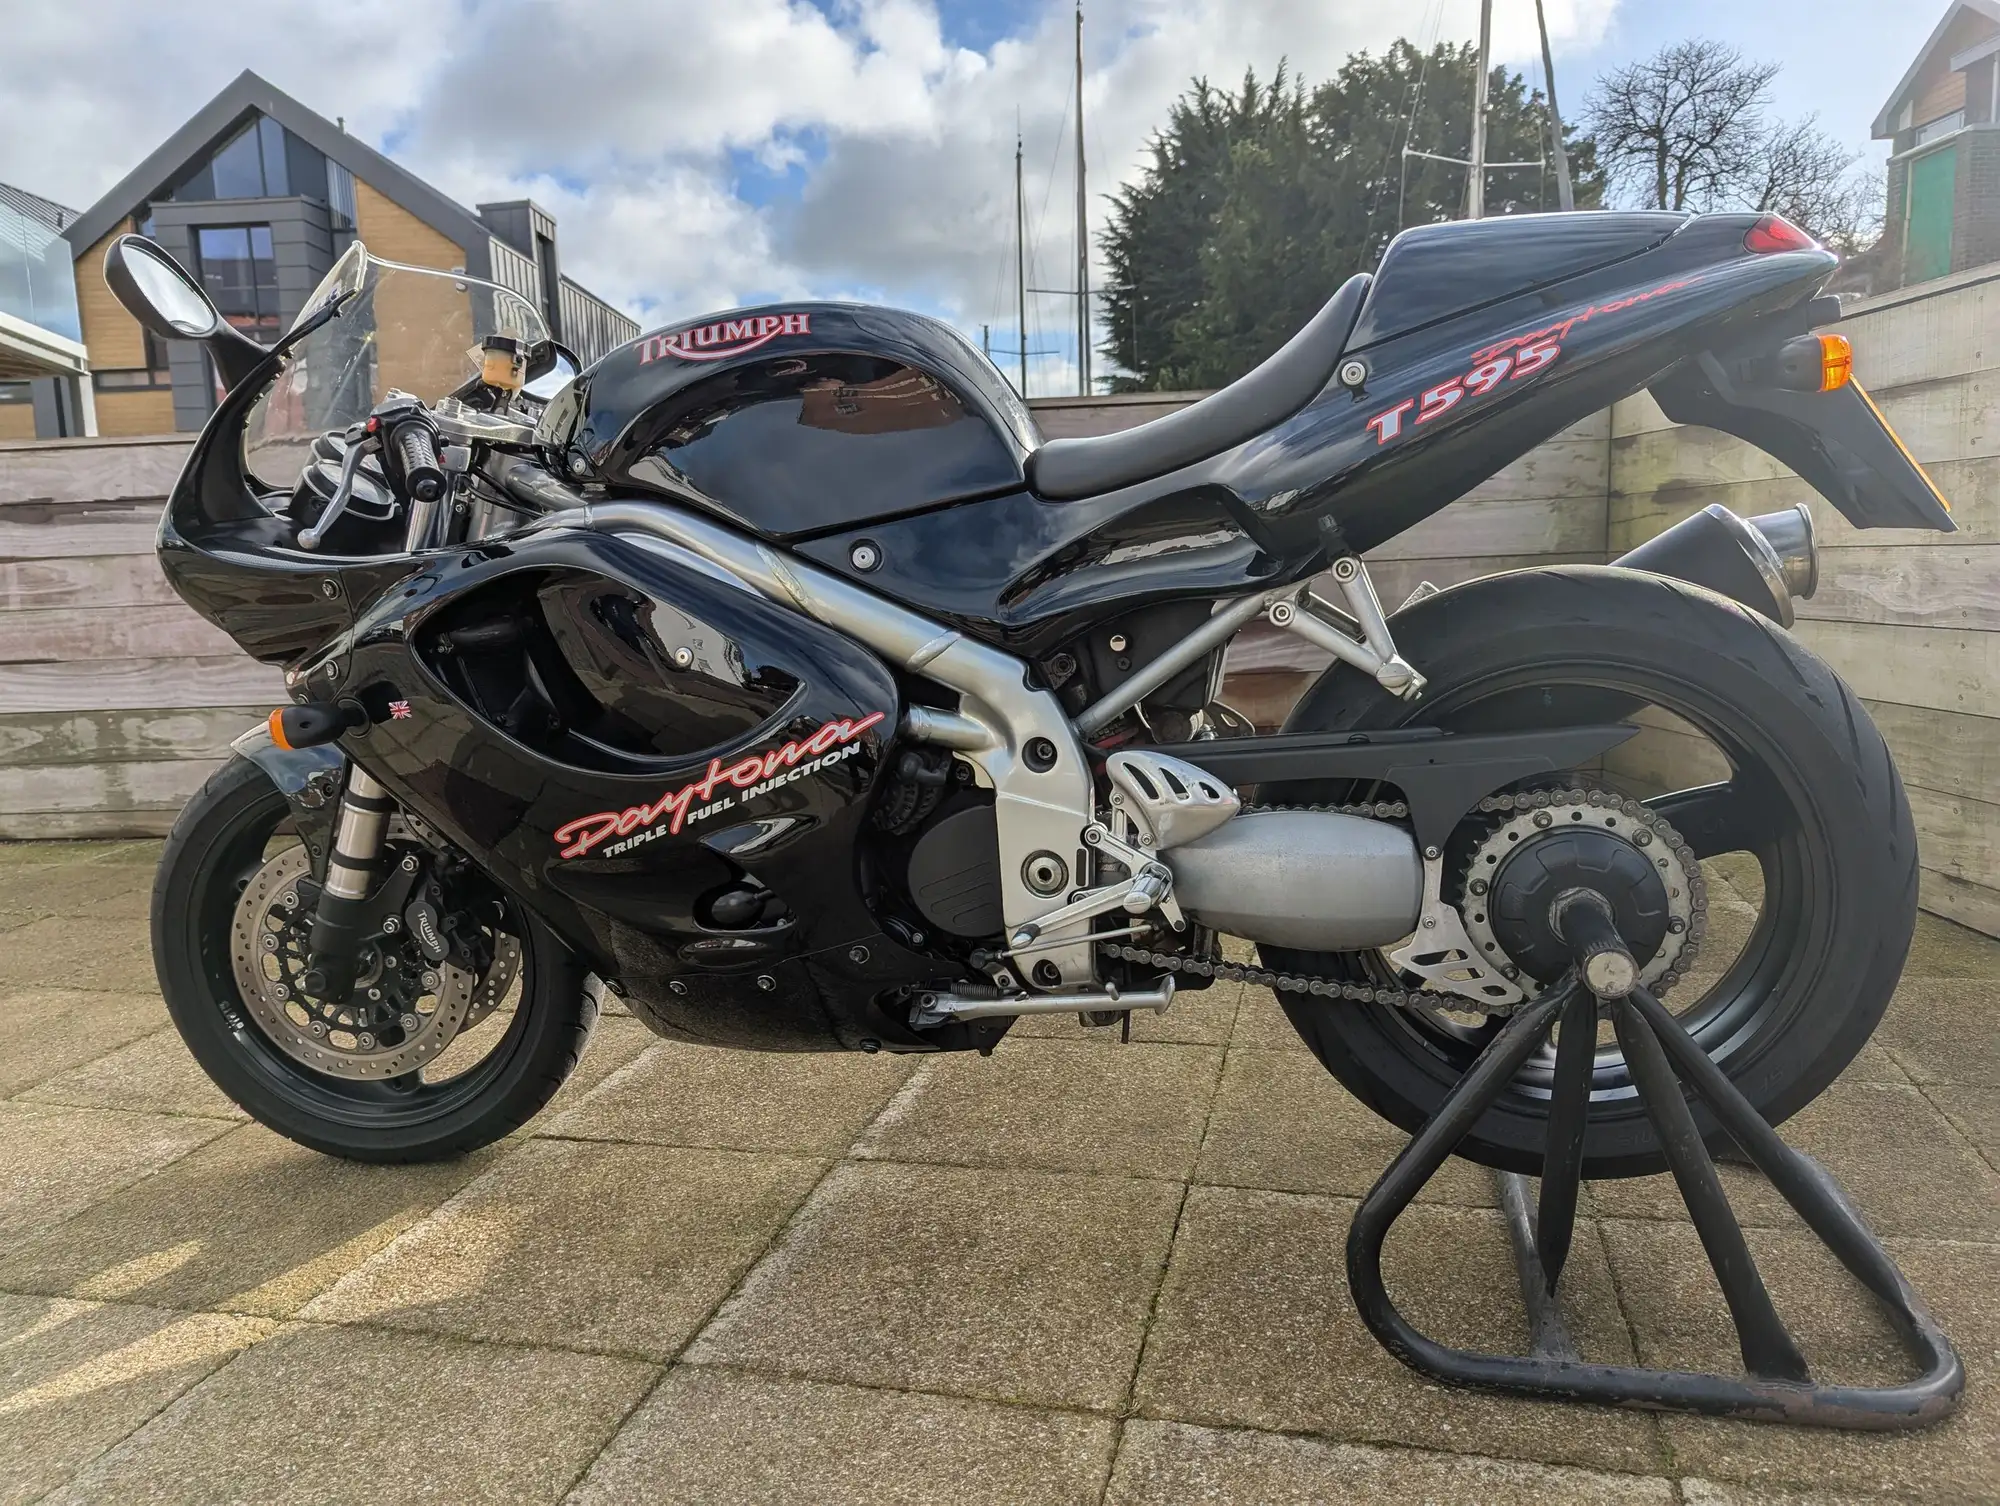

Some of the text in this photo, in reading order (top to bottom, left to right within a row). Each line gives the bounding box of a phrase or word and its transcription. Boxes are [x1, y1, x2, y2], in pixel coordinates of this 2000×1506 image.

[633, 313, 811, 366] TRIUMPH
[1471, 276, 1702, 365] Daytona
[1366, 338, 1561, 445] T595
[554, 711, 885, 859] Daytona
[603, 741, 861, 858] TRIPLE FUEL INJECTION
[417, 909, 442, 953] TRIUMPH
